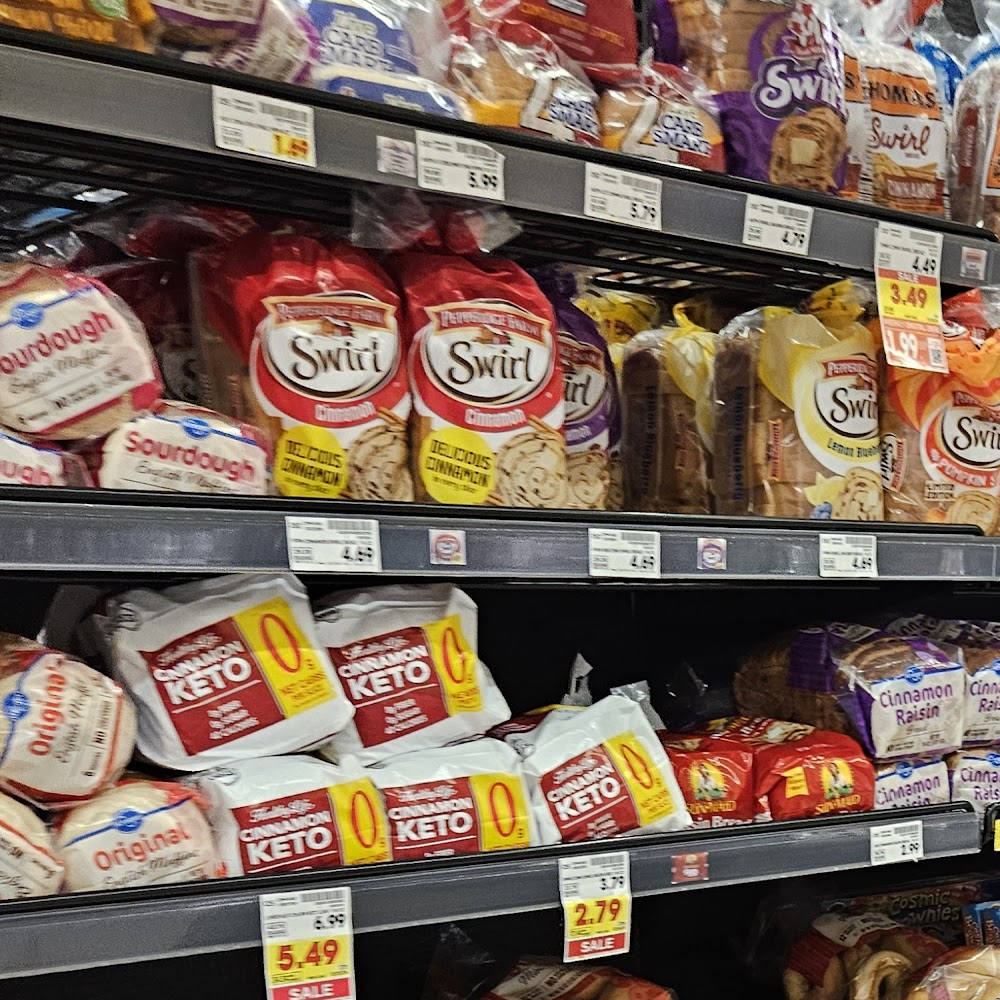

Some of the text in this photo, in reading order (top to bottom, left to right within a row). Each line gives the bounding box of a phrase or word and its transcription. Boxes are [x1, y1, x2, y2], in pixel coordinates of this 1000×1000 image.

[871, 117, 930, 155] Swirl
[912, 256, 937, 275] 4.49
[890, 287, 928, 310] 3.49
[290, 334, 382, 380] Swirl
[448, 340, 534, 385] Swirl
[126, 430, 256, 483] Sourdough
[163, 656, 251, 705] KETO
[349, 661, 432, 701] KETO
[880, 683, 953, 708] Cinnamon
[896, 705, 939, 724] Raisin
[555, 776, 622, 822] KETO
[396, 811, 474, 842] KETO
[94, 822, 190, 870] Original
[247, 827, 333, 866] KETO
[901, 841, 919, 857] 2.99
[313, 913, 345, 931] 6.99
[574, 898, 621, 928] 2.79
[276, 938, 339, 971] 5.49
[579, 937, 615, 953] SALE
